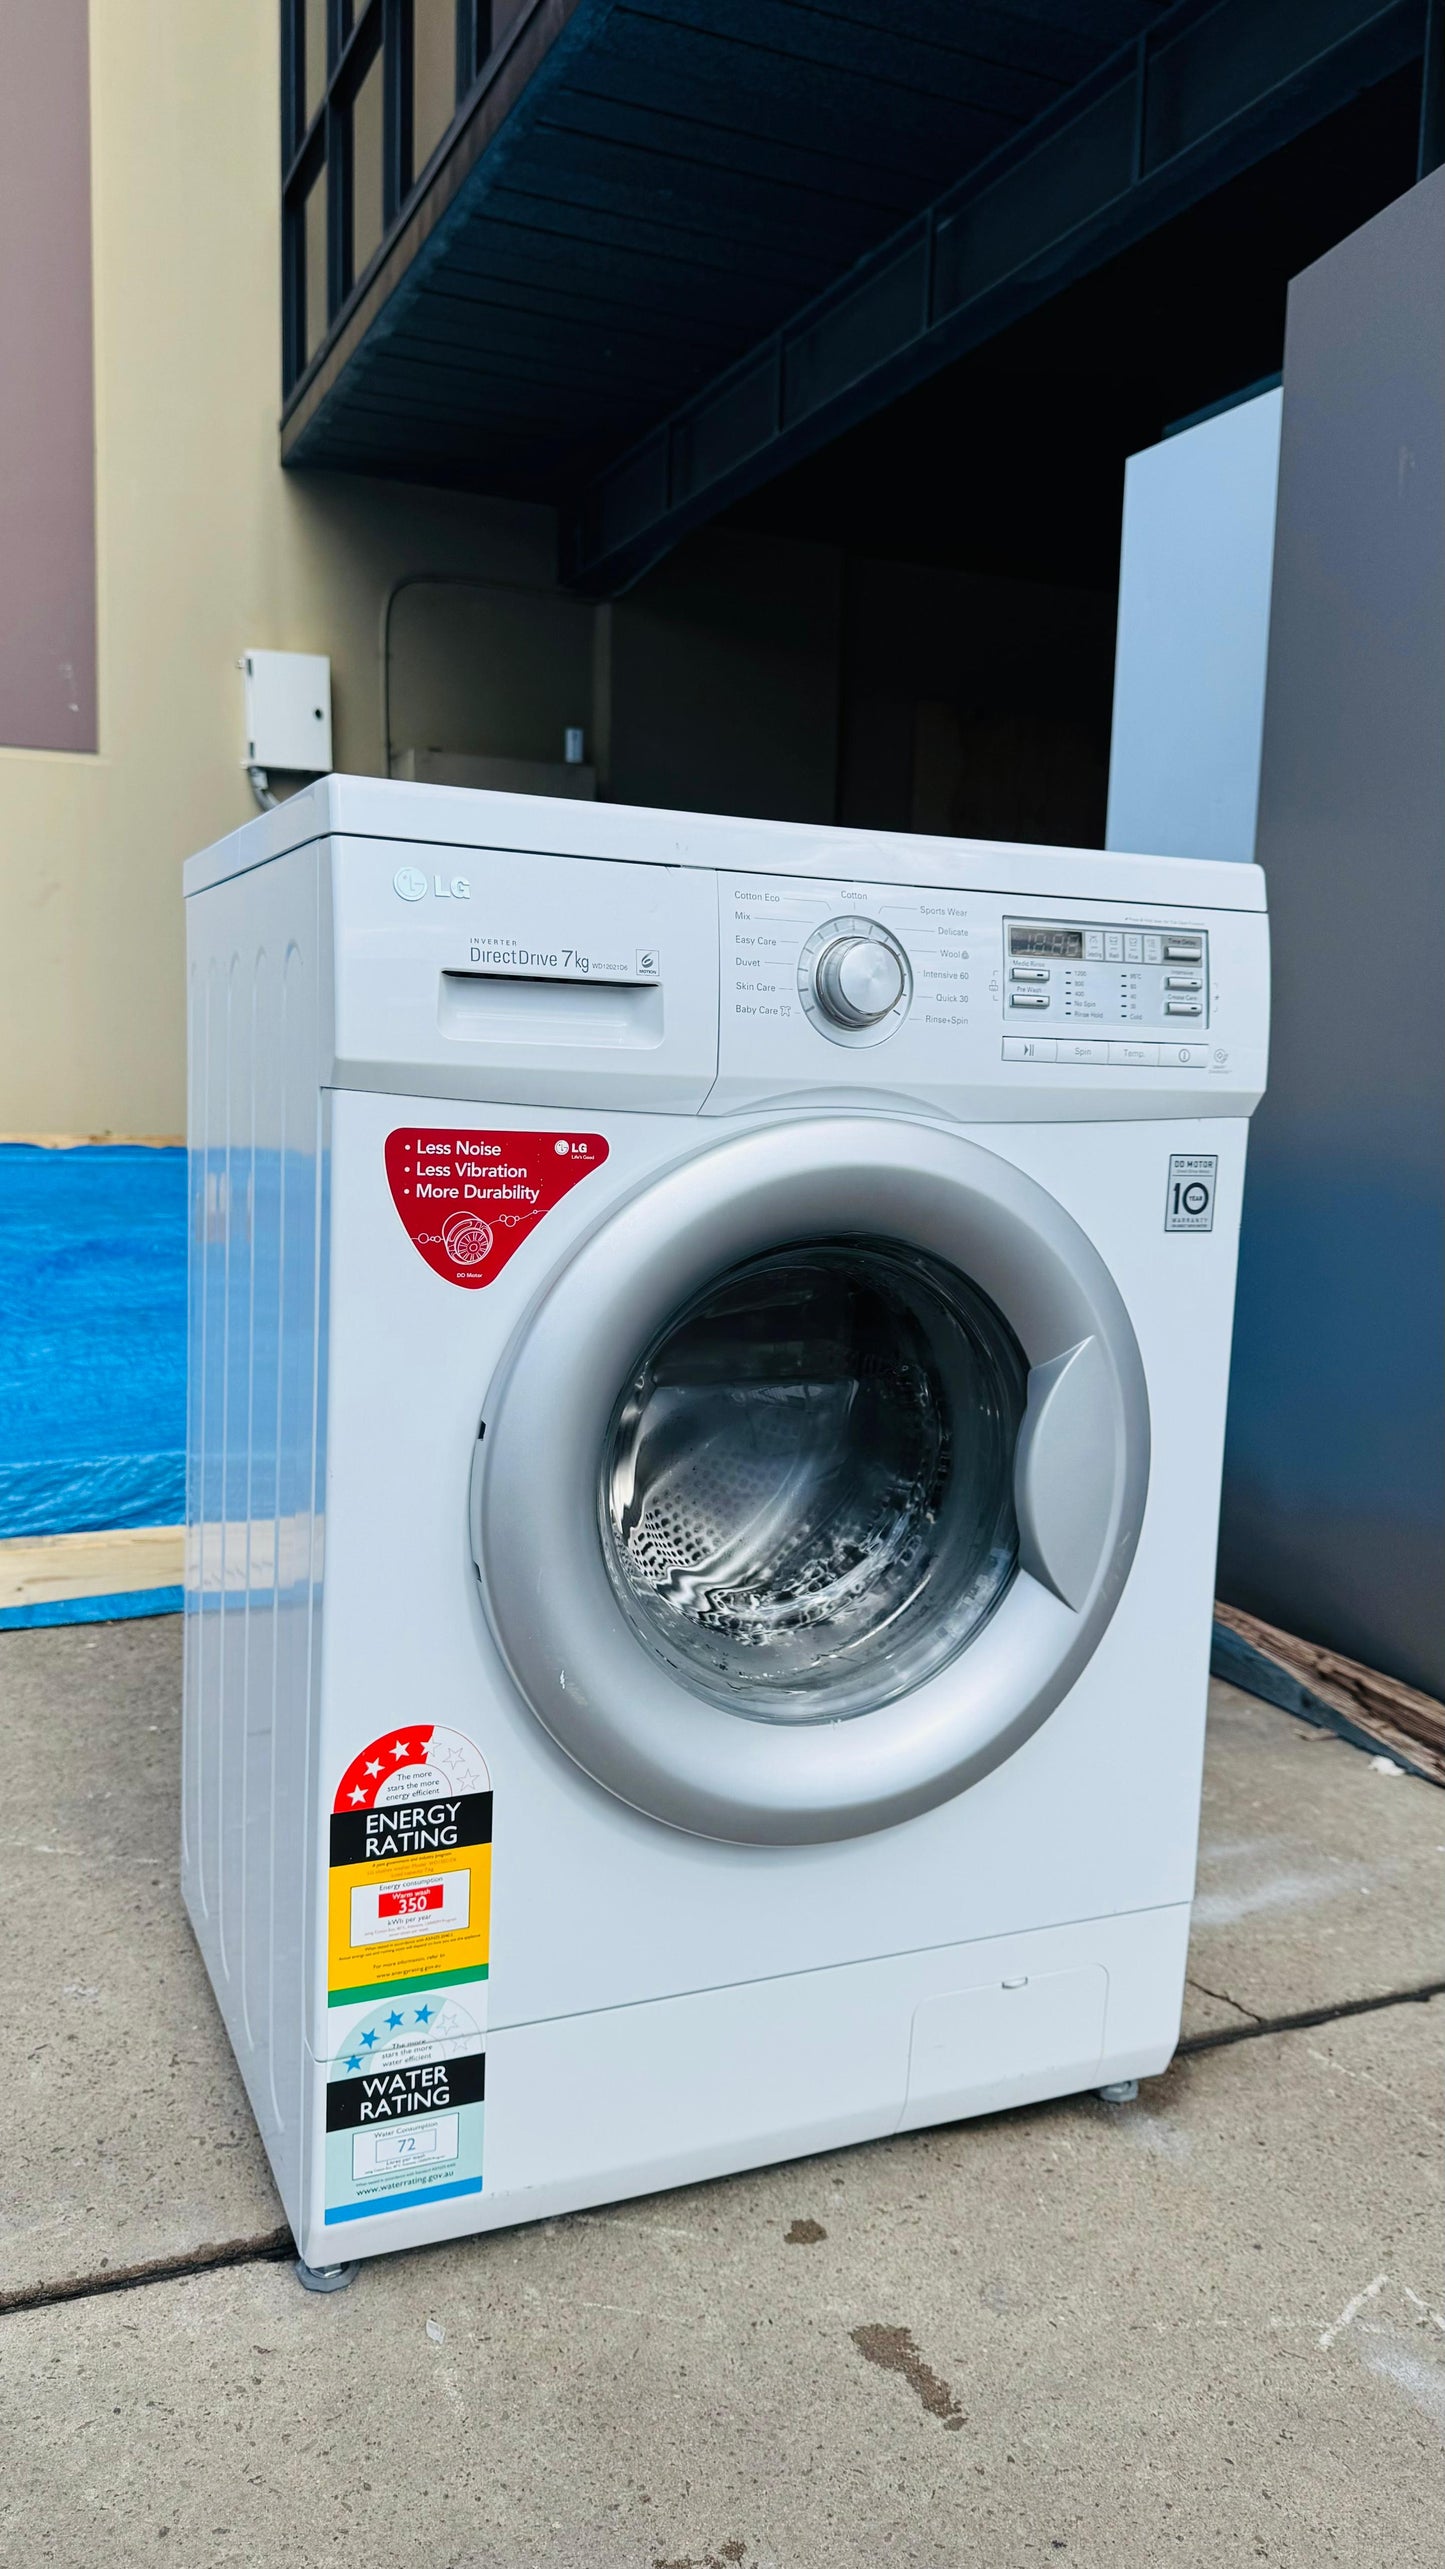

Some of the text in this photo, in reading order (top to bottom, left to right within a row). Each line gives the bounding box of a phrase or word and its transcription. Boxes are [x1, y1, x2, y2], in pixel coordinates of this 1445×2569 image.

[434, 874, 471, 900] LG
[734, 890, 780, 903] Cotton Eco
[841, 890, 868, 900] Cotton
[734, 912, 751, 921] Mix
[920, 906, 968, 918] Sports Wear
[938, 927, 969, 937] Delicate
[470, 938, 517, 947] INVERTER
[736, 936, 777, 946] Easy Care
[940, 950, 961, 959] Wool
[736, 958, 761, 968] Duvet
[923, 970, 969, 980] Intensive 60
[736, 982, 776, 992] Skin Care
[936, 994, 969, 1004] Quick 30
[736, 1005, 778, 1016] Baby Care
[1074, 1048, 1092, 1057] Spin
[416, 1140, 502, 1157] Less Noise
[572, 1143, 588, 1154] LG
[416, 1162, 528, 1179] Less Vibration
[416, 1184, 540, 1204] More Durability
[1173, 1182, 1209, 1215] 10
[397, 1774, 411, 1782] The
[407, 1782, 418, 1790] the
[421, 1780, 440, 1788] more
[386, 1788, 440, 1802] energy efficient
[366, 1802, 462, 1835] ENERGY
[366, 1825, 458, 1858] RATING
[380, 1877, 443, 1892] Energy consumption
[392, 1888, 431, 1900] Warm wash
[398, 1896, 427, 1914] 350
[388, 1914, 432, 1926] kWh per year
[406, 2040, 426, 2048] more
[383, 2053, 432, 2068] water efficient
[362, 2065, 449, 2099] WATER
[360, 2086, 450, 2122] RATING
[375, 2122, 438, 2139] Water Consumption
[398, 2138, 416, 2153] 72
[356, 2171, 454, 2196] www.waterrating.gov.au
